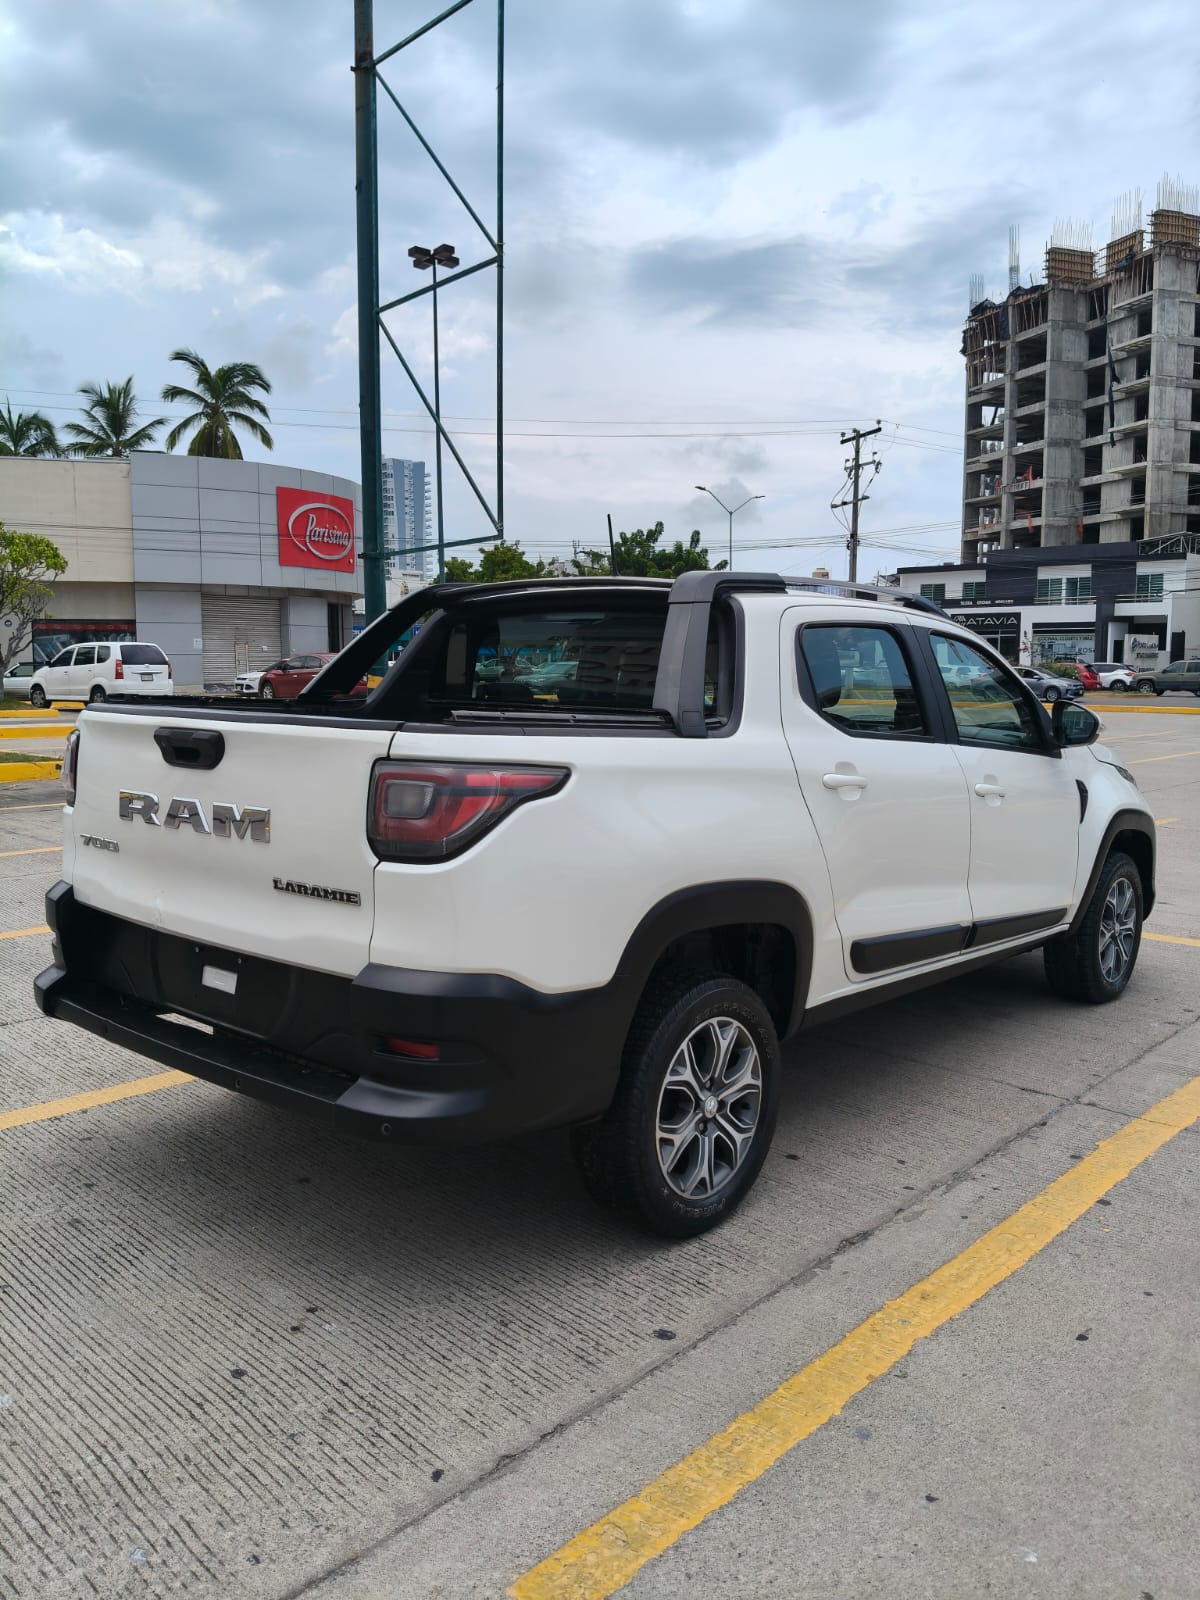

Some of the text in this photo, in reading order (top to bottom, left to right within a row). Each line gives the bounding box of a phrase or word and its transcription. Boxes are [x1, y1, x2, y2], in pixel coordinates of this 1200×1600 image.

[306, 513, 349, 546] Parisina
[118, 788, 271, 844] RAM
[79, 832, 120, 854] 700
[272, 876, 361, 906] LARAMIE
